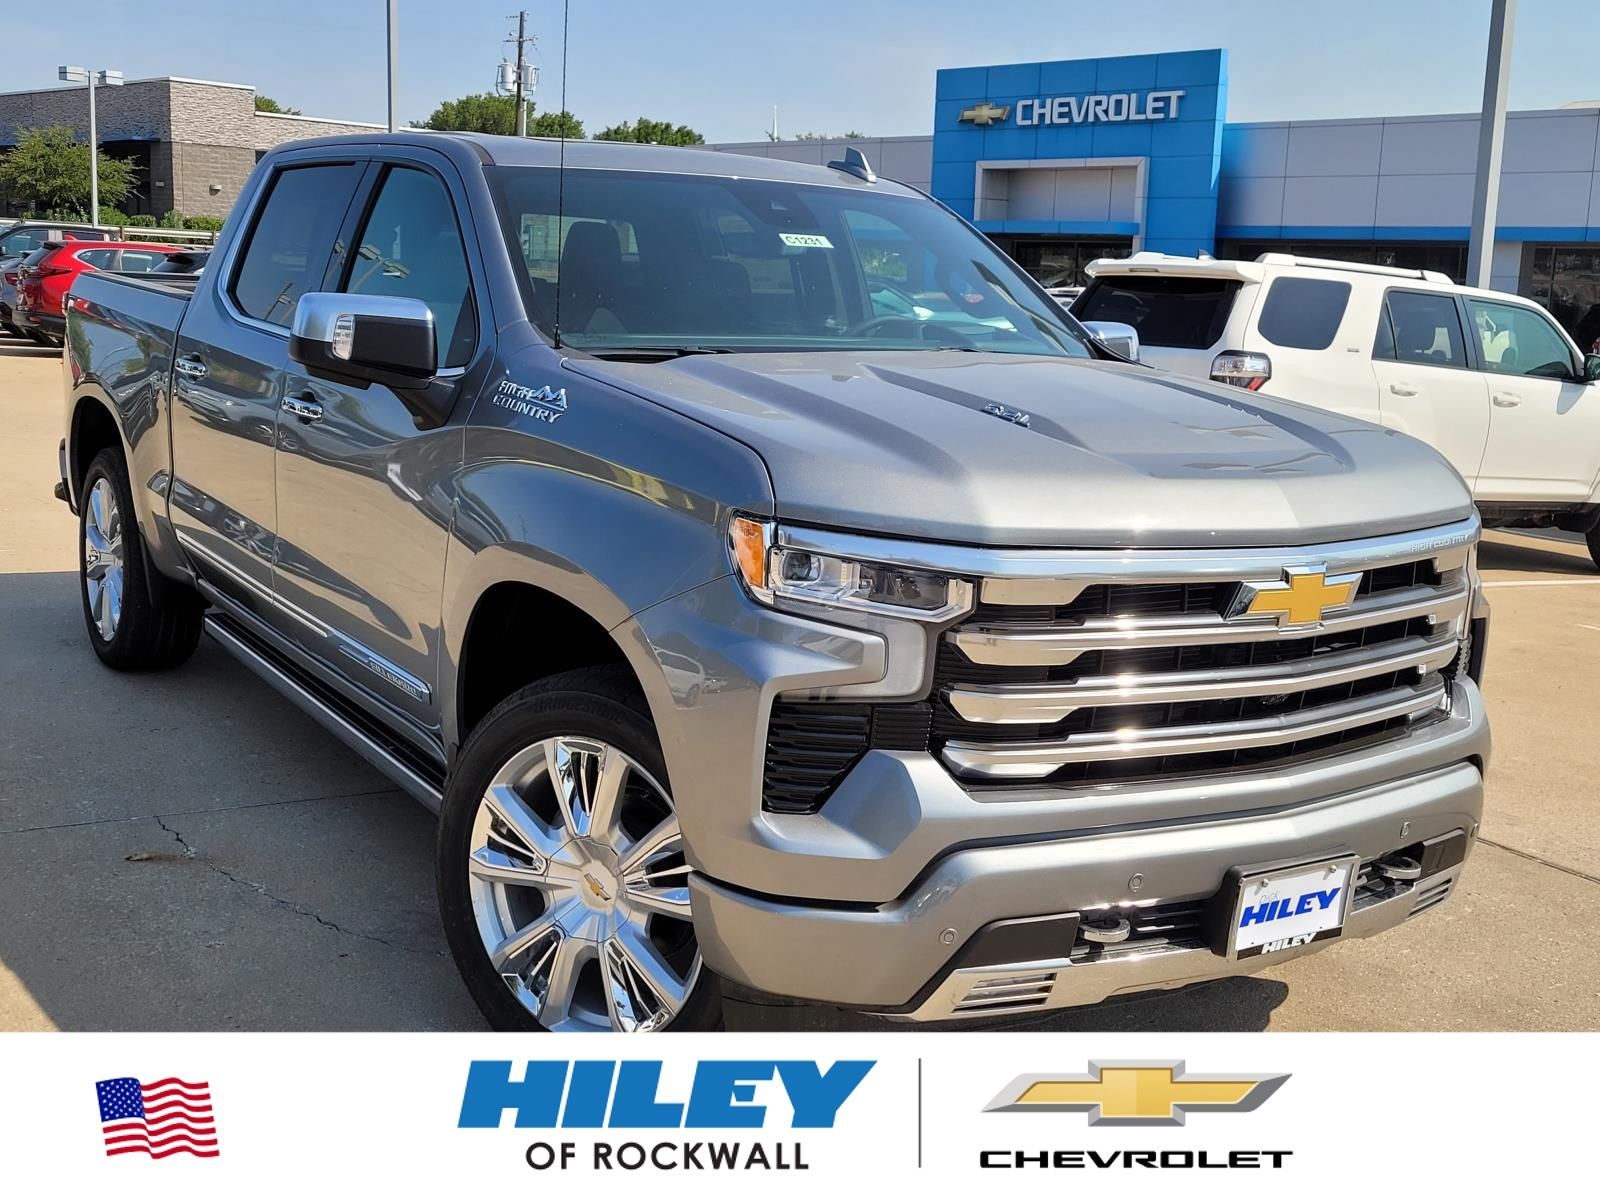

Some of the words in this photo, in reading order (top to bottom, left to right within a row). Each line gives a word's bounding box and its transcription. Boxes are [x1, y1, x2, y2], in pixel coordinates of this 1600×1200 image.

[1016, 90, 1186, 125] CHEVROLET
[785, 236, 824, 246] C1231
[493, 395, 562, 423] COUNTRY
[1240, 887, 1342, 928] HILEY
[1261, 932, 1317, 954] HILEY
